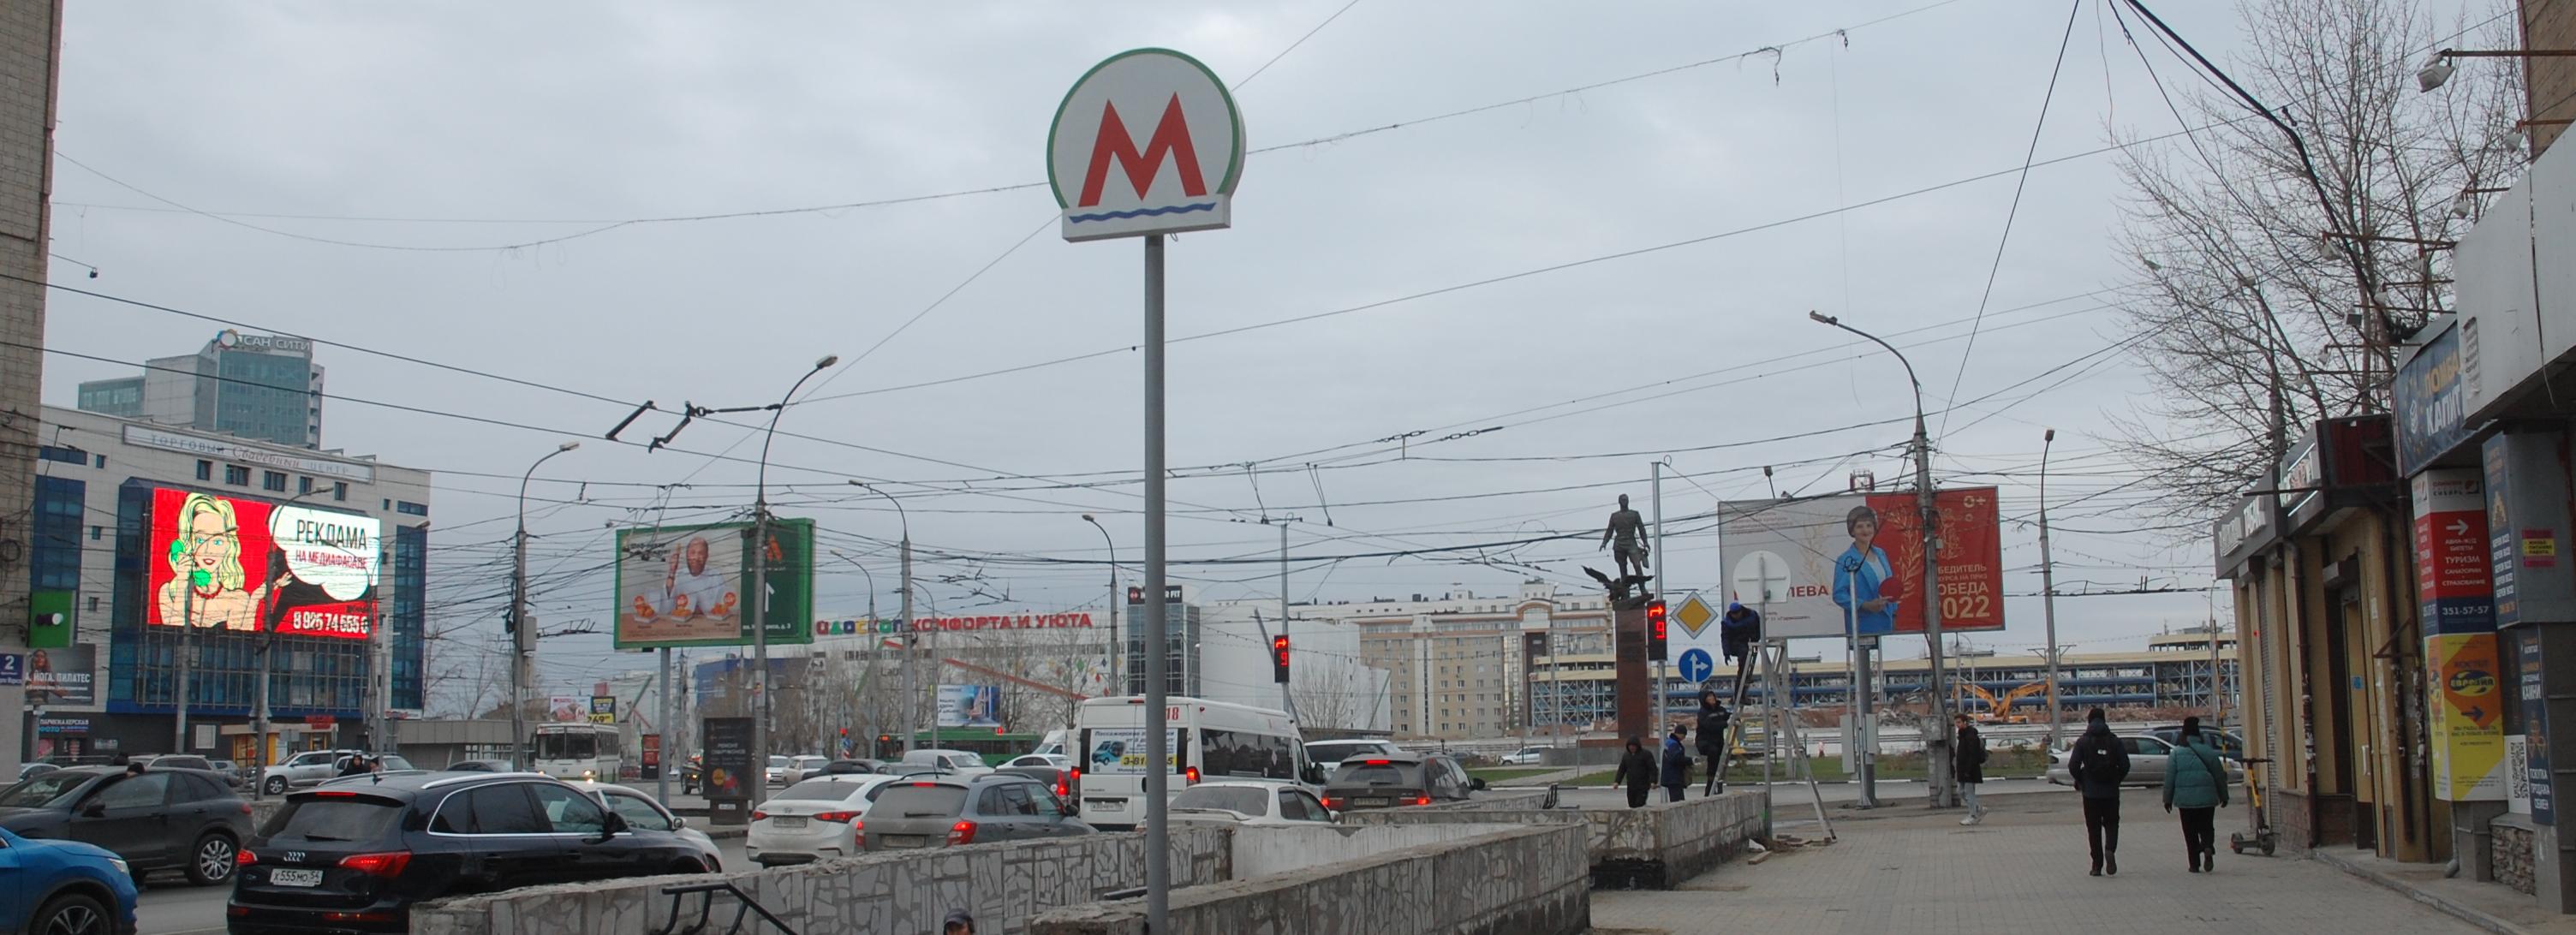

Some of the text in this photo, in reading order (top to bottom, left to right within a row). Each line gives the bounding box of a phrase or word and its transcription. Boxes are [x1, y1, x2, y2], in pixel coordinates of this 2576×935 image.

[1077, 91, 1208, 208] М
[244, 336, 310, 351] САН СИТИ
[2426, 384, 2461, 437] КАПИТ
[150, 433, 225, 456] ТОРГОВЫЙ
[309, 461, 349, 474] ЦЕНТР
[296, 519, 367, 551] РЕКЛАМА
[295, 550, 307, 563] НА
[1937, 564, 1987, 575] БЕДИТЕЛЬ
[1937, 582, 1989, 596] ОБЕДА
[1941, 595, 1991, 619] 022
[2442, 605, 2490, 616] 351-57-57
[911, 616, 1013, 632] КОМФОРТА
[1017, 615, 1030, 629] И
[1035, 613, 1093, 629] УЮТА
[1655, 621, 1666, 640] 9
[4, 655, 15, 670] 2
[57, 672, 91, 684] ПИЛАТЕС
